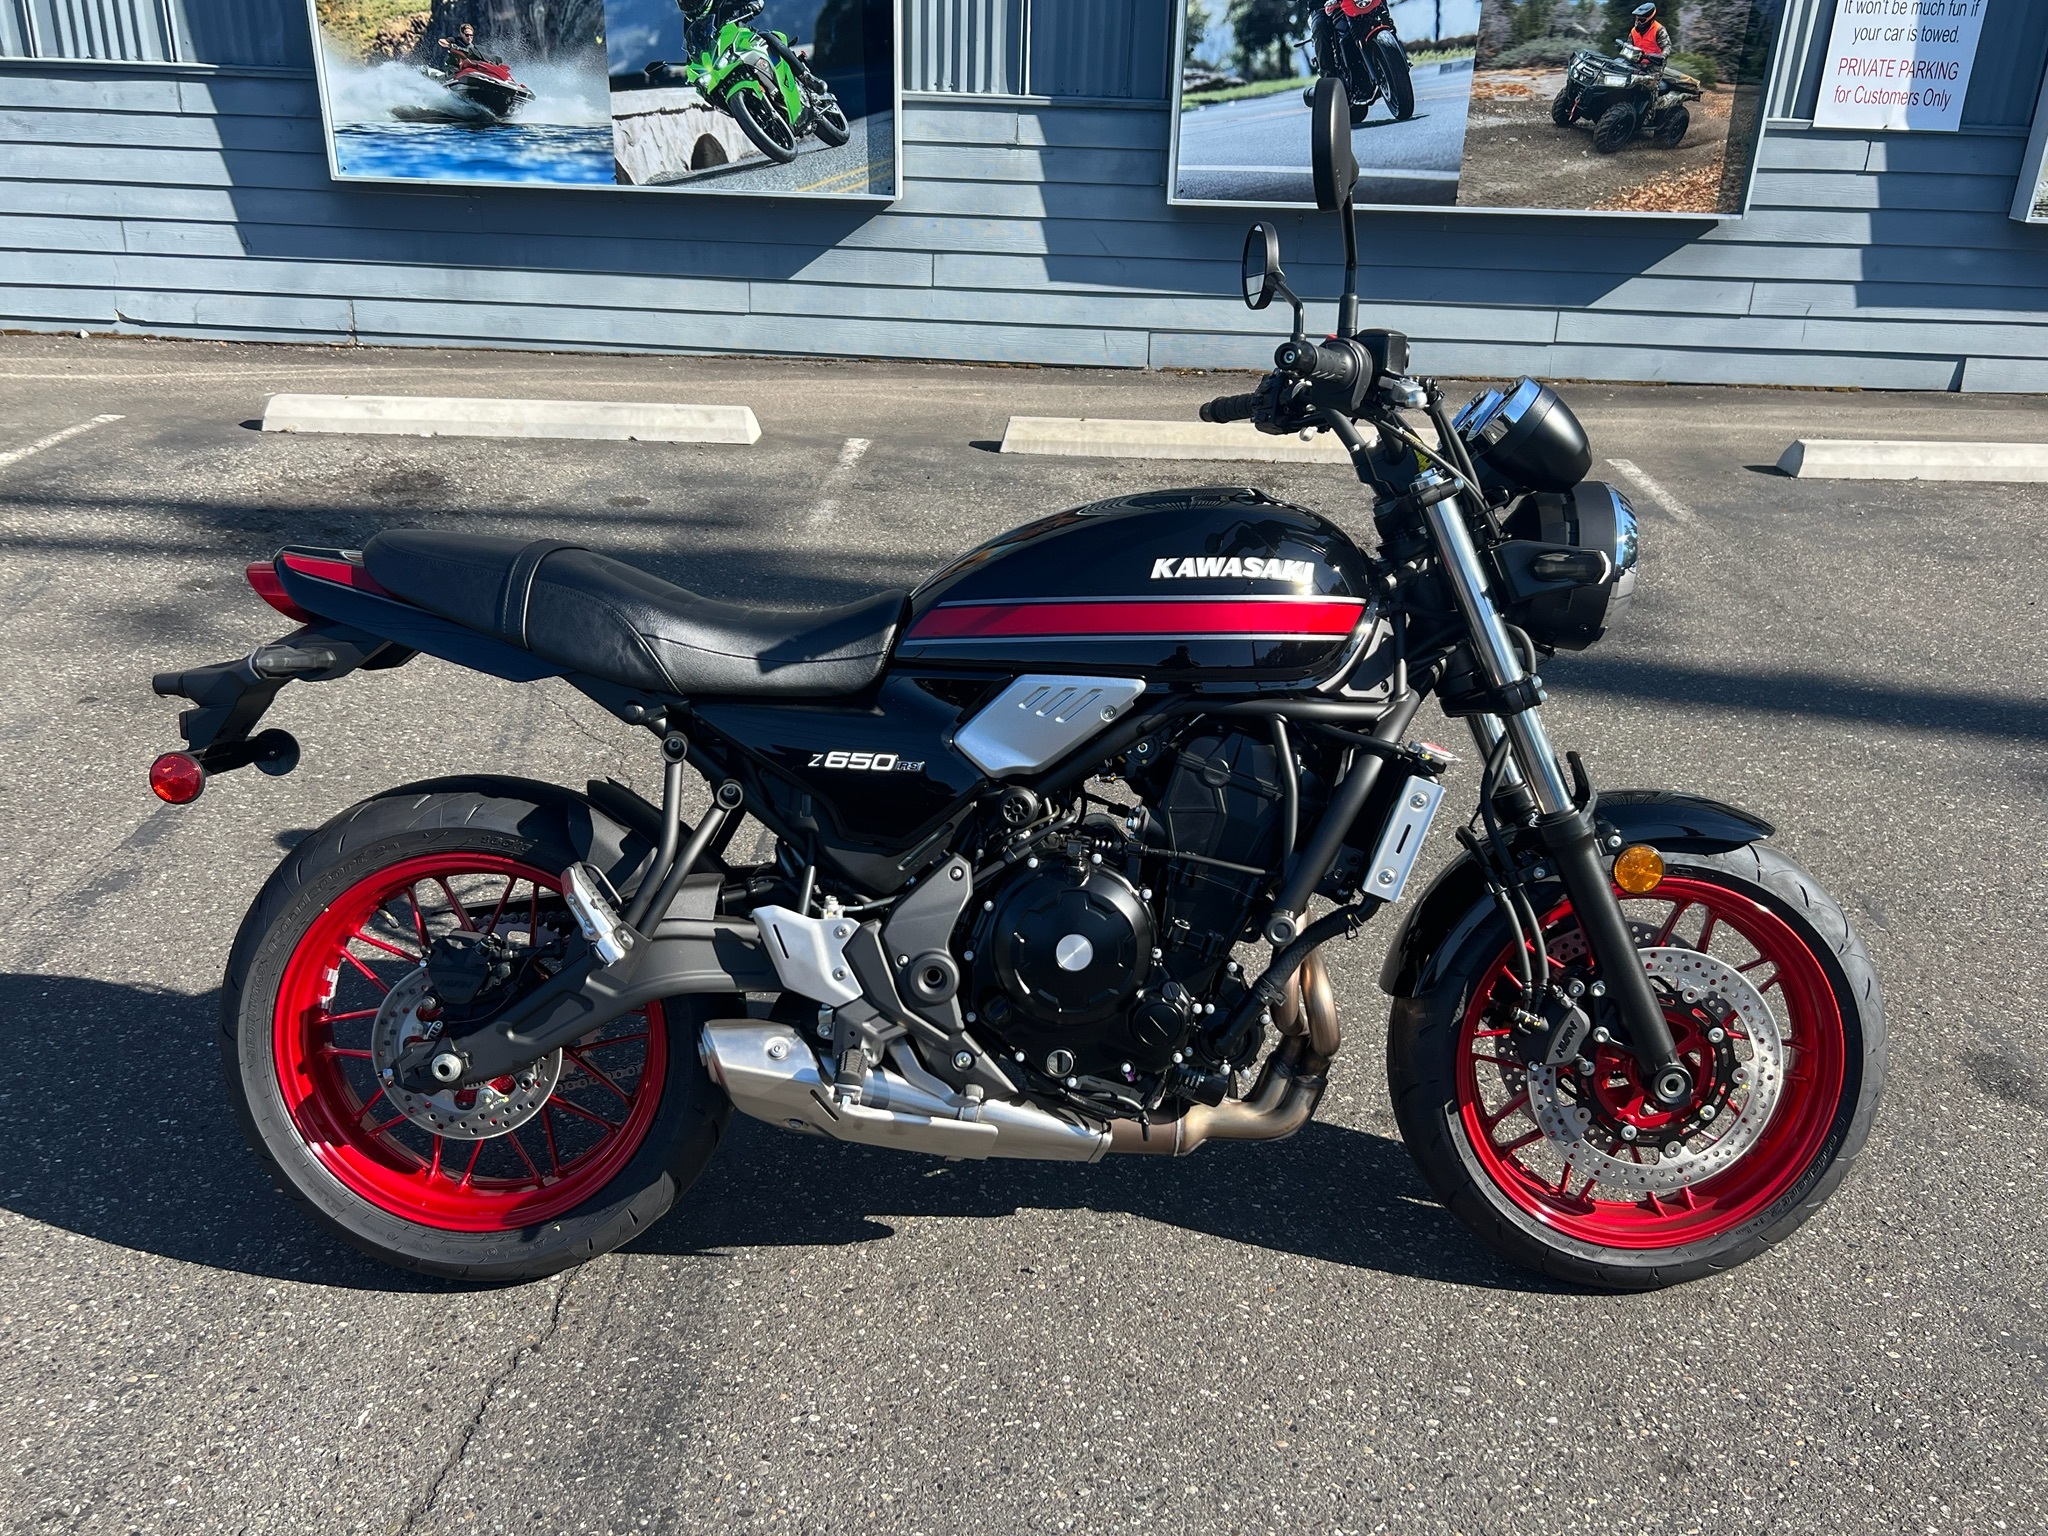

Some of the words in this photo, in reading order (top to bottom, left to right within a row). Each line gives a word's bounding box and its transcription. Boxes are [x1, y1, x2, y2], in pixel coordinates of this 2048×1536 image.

[1844, 0, 1852, 14] It
[1856, 0, 1889, 15] won't
[1891, 0, 1907, 16] be
[1910, 0, 1945, 17] much
[1949, 0, 1967, 17] fun
[1970, 0, 1981, 17] if
[1852, 27, 1882, 45] your
[1884, 28, 1905, 42] car
[1906, 24, 1918, 42] is
[1921, 25, 1960, 43] towed.
[1837, 58, 1897, 78] PRIVATE
[1898, 60, 1960, 81] PARKING
[1834, 85, 1852, 103] for
[1854, 86, 1920, 106] Customers
[1923, 88, 1952, 112] Only
[1150, 557, 1315, 585] KAWASAKI
